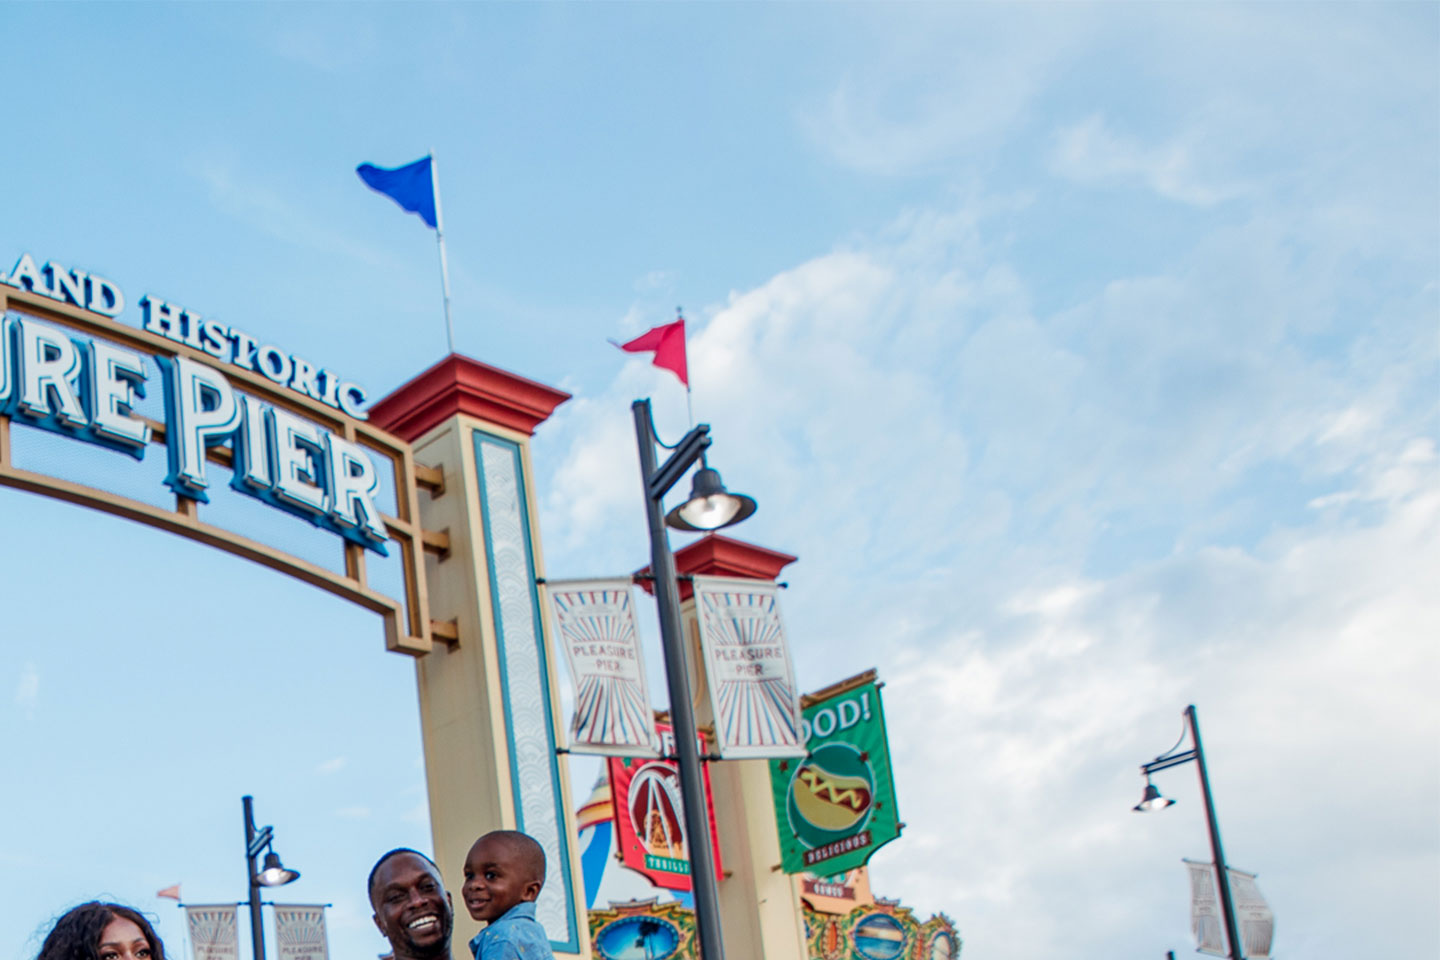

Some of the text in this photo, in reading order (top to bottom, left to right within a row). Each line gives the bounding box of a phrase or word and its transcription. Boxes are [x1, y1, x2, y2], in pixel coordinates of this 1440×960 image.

[141, 295, 369, 421] HISTORIC
[159, 354, 389, 553] PIER
[572, 644, 635, 660] PLEASURE
[714, 647, 782, 661] PLEASURE
[596, 659, 622, 672] PIER
[736, 663, 764, 676] PIER
[807, 833, 867, 865] DELICIOUS
